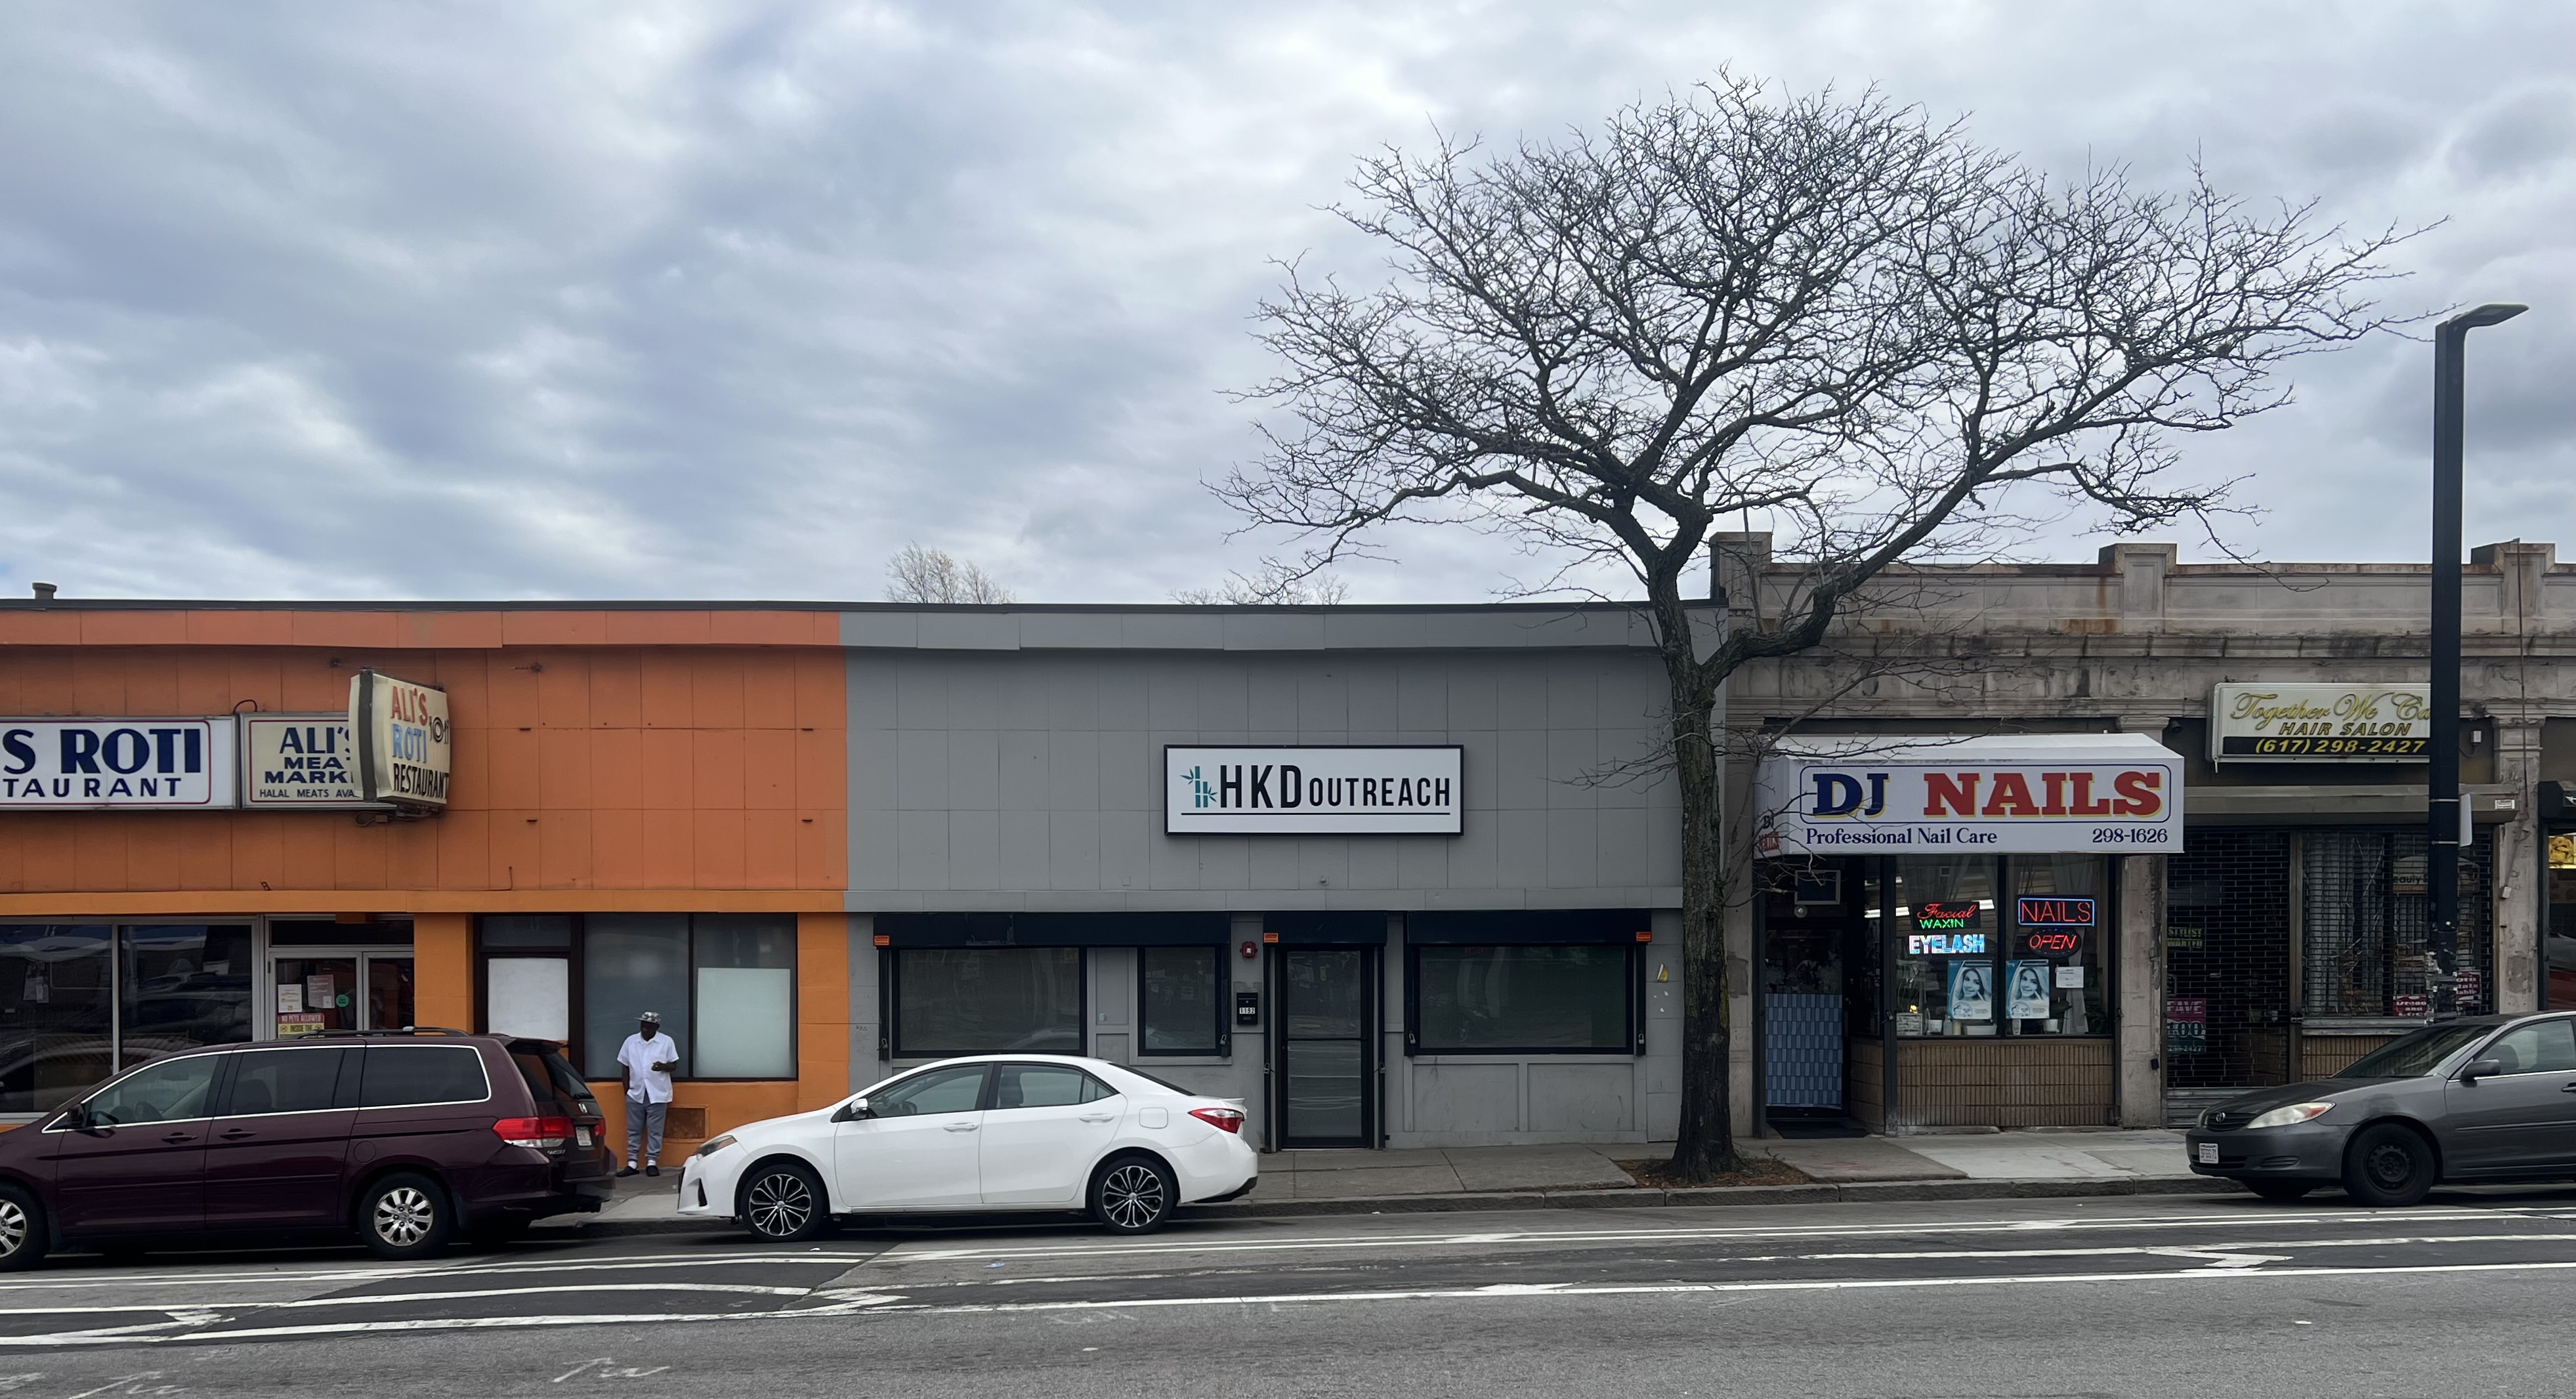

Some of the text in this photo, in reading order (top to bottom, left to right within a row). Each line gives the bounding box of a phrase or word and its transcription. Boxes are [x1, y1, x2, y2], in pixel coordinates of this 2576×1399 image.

[390, 686, 428, 726] ALI'S
[2230, 692, 2331, 730] Together
[2334, 692, 2389, 720] We
[2279, 722, 2412, 736] HAIR SALON
[60, 728, 201, 774] ROTI
[392, 723, 427, 763] ROTI
[2255, 739, 2426, 753] (617) 298-2427
[284, 757, 350, 769] MEA
[264, 771, 354, 783] MARK
[393, 763, 449, 799] RESTAURANT
[1220, 765, 1450, 808] HKD OUTREACH
[3, 778, 182, 797] TAURANT
[297, 789, 329, 797] MEATS
[1812, 771, 2163, 818] DJ NAILS
[1806, 827, 1998, 844] Professional Nail Care
[2092, 828, 2168, 843] 298-1626
[1916, 903, 1977, 919] Facial
[2021, 901, 2091, 922] NAILS
[1909, 934, 1985, 954] EYELASH
[2029, 934, 2077, 950] OPEN
